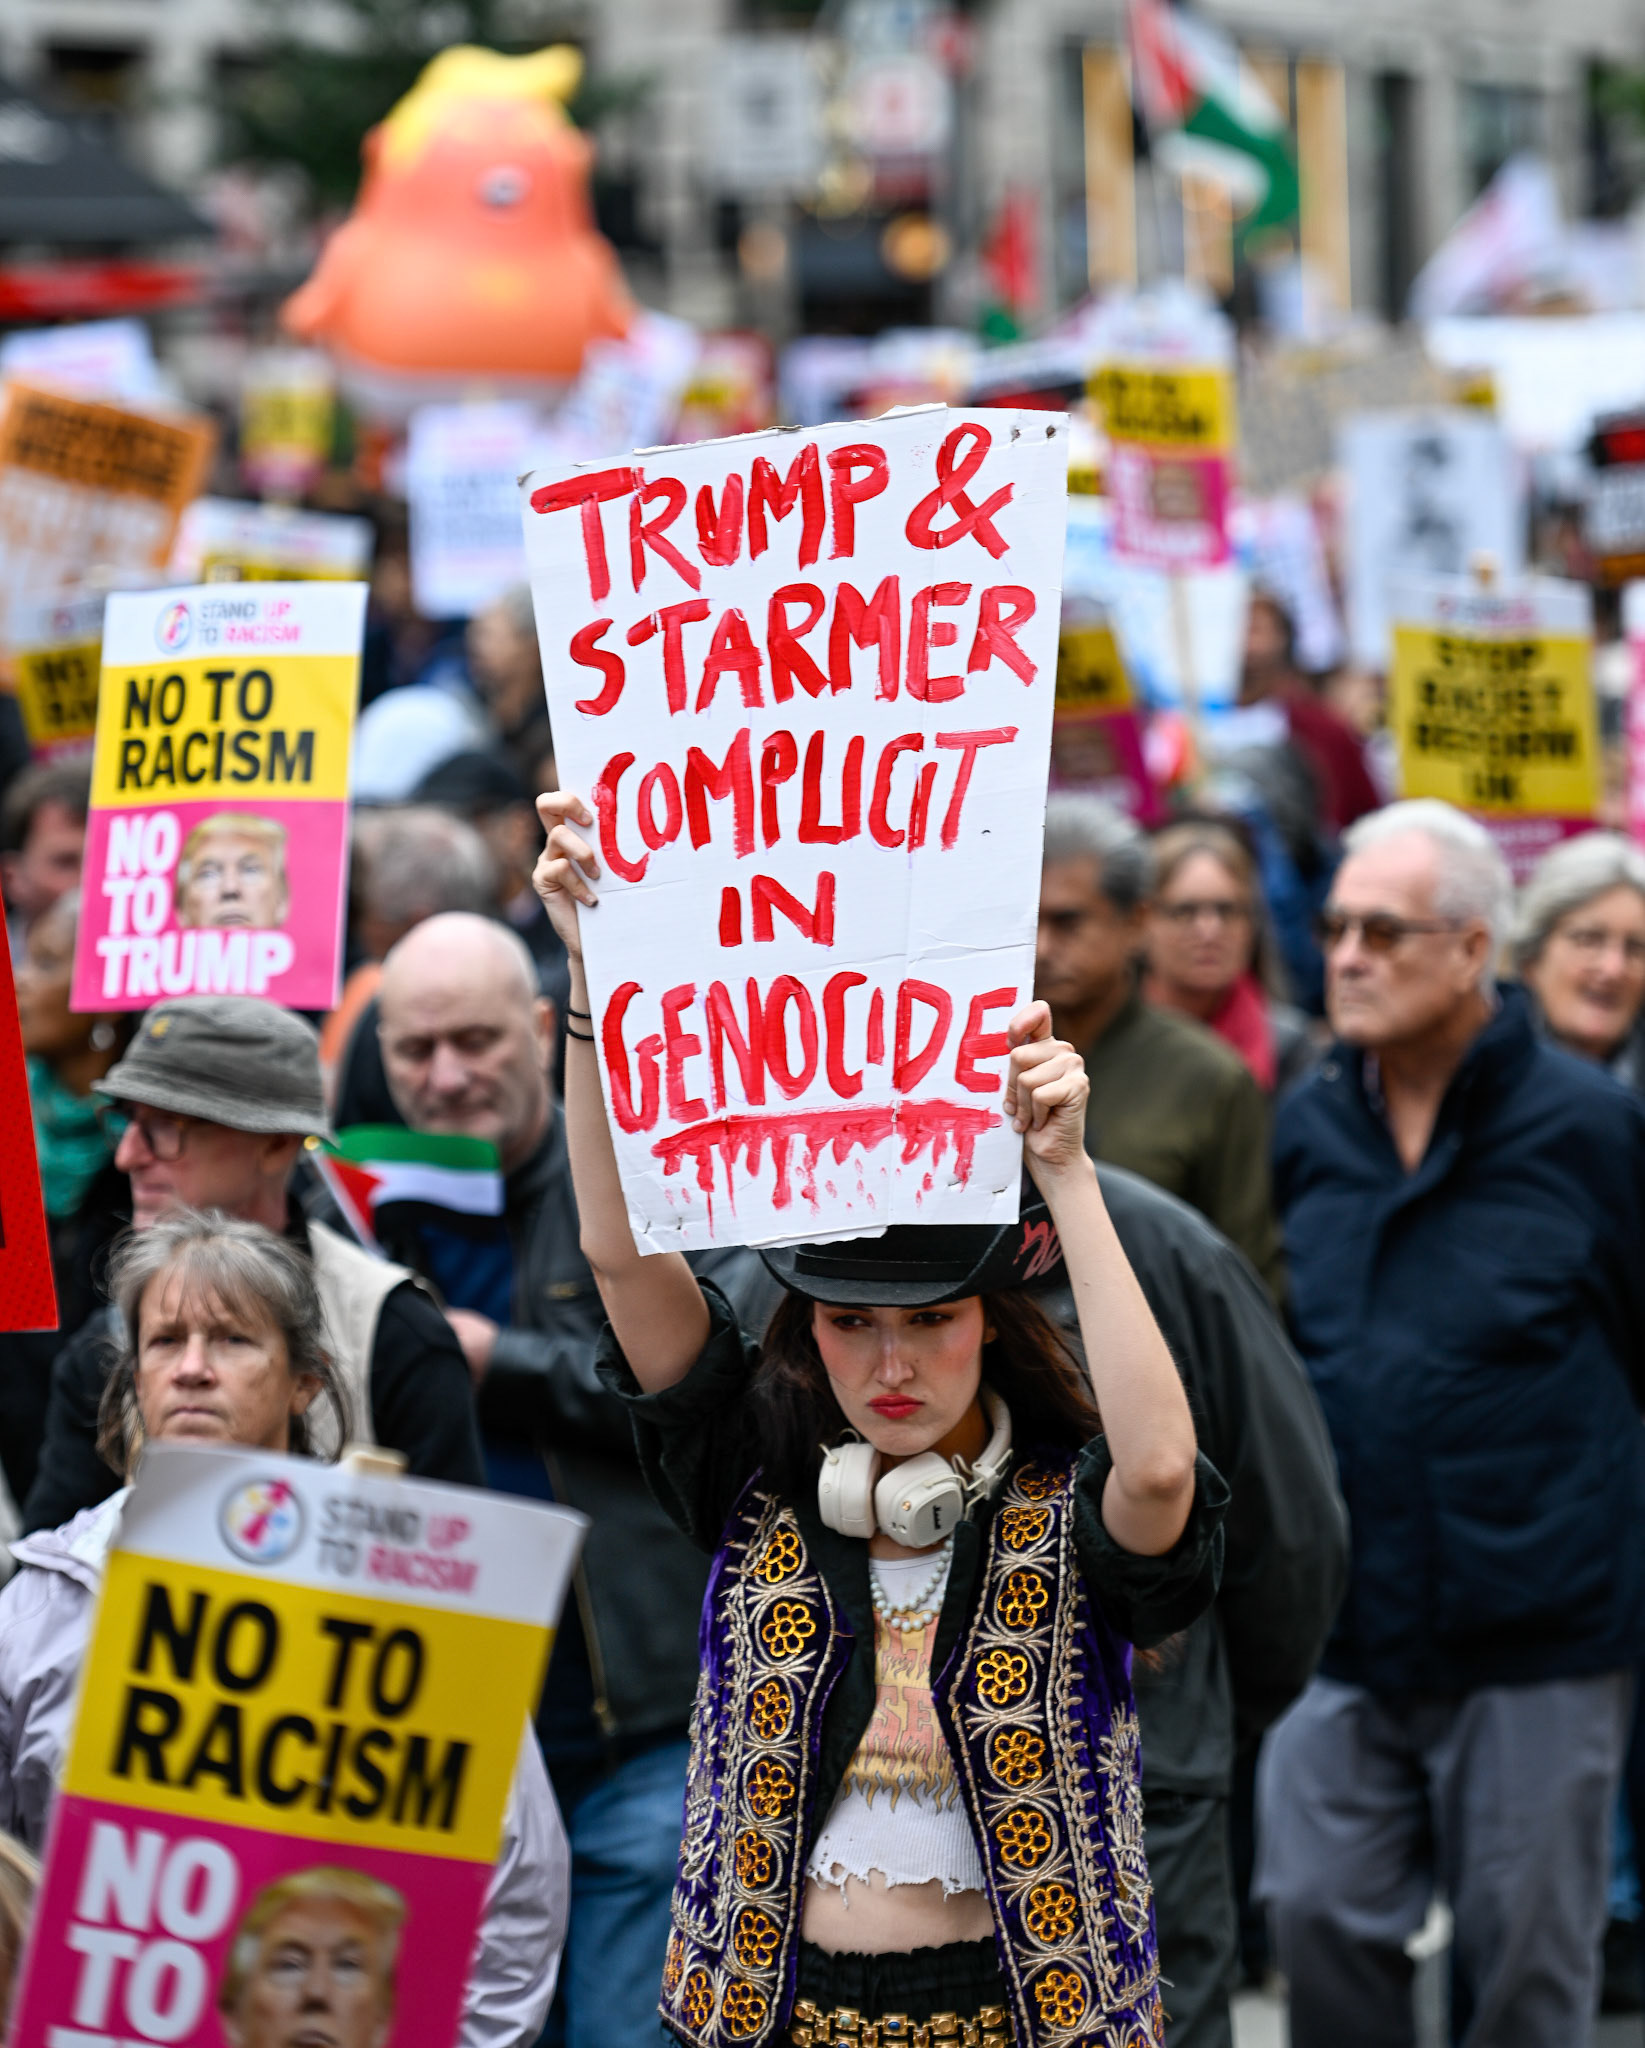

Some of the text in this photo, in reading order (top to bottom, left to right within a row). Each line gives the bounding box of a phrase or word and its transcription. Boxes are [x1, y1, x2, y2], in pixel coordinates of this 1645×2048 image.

[530, 442, 890, 602] TRUMP
[905, 422, 1015, 560] &
[570, 575, 1038, 717] STARMER
[123, 674, 187, 730] NO
[204, 669, 274, 723] TO
[117, 730, 315, 791] RACISM
[591, 727, 1020, 882] COMPLICIT
[105, 811, 181, 876] NO
[102, 874, 169, 936] TO
[719, 871, 837, 947] IN
[96, 929, 295, 999] TRUMP
[602, 971, 1020, 1133] GENOCIDE
[317, 1536, 480, 1594] TO RACISM
[321, 1497, 472, 1550] STAND UP
[131, 1582, 427, 1720] NO TO
[109, 1683, 473, 1836] RACISM
[77, 1820, 240, 1943] NO
[66, 1921, 210, 2043] TO
